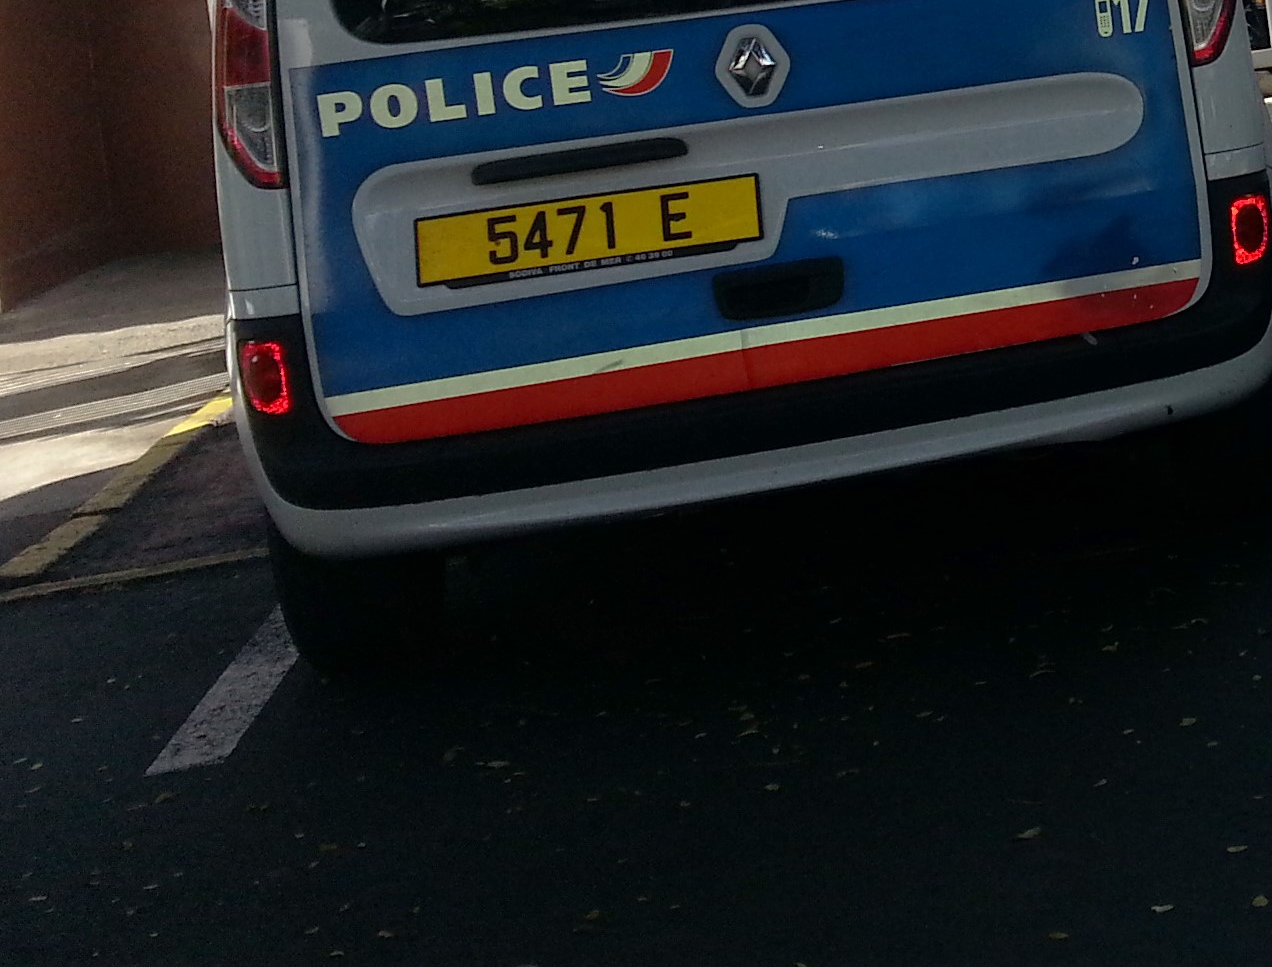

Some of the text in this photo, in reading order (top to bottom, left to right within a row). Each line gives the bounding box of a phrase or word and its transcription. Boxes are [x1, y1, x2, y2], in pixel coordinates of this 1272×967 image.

[316, 59, 592, 138] POLICE
[487, 191, 693, 265] 5471 E
